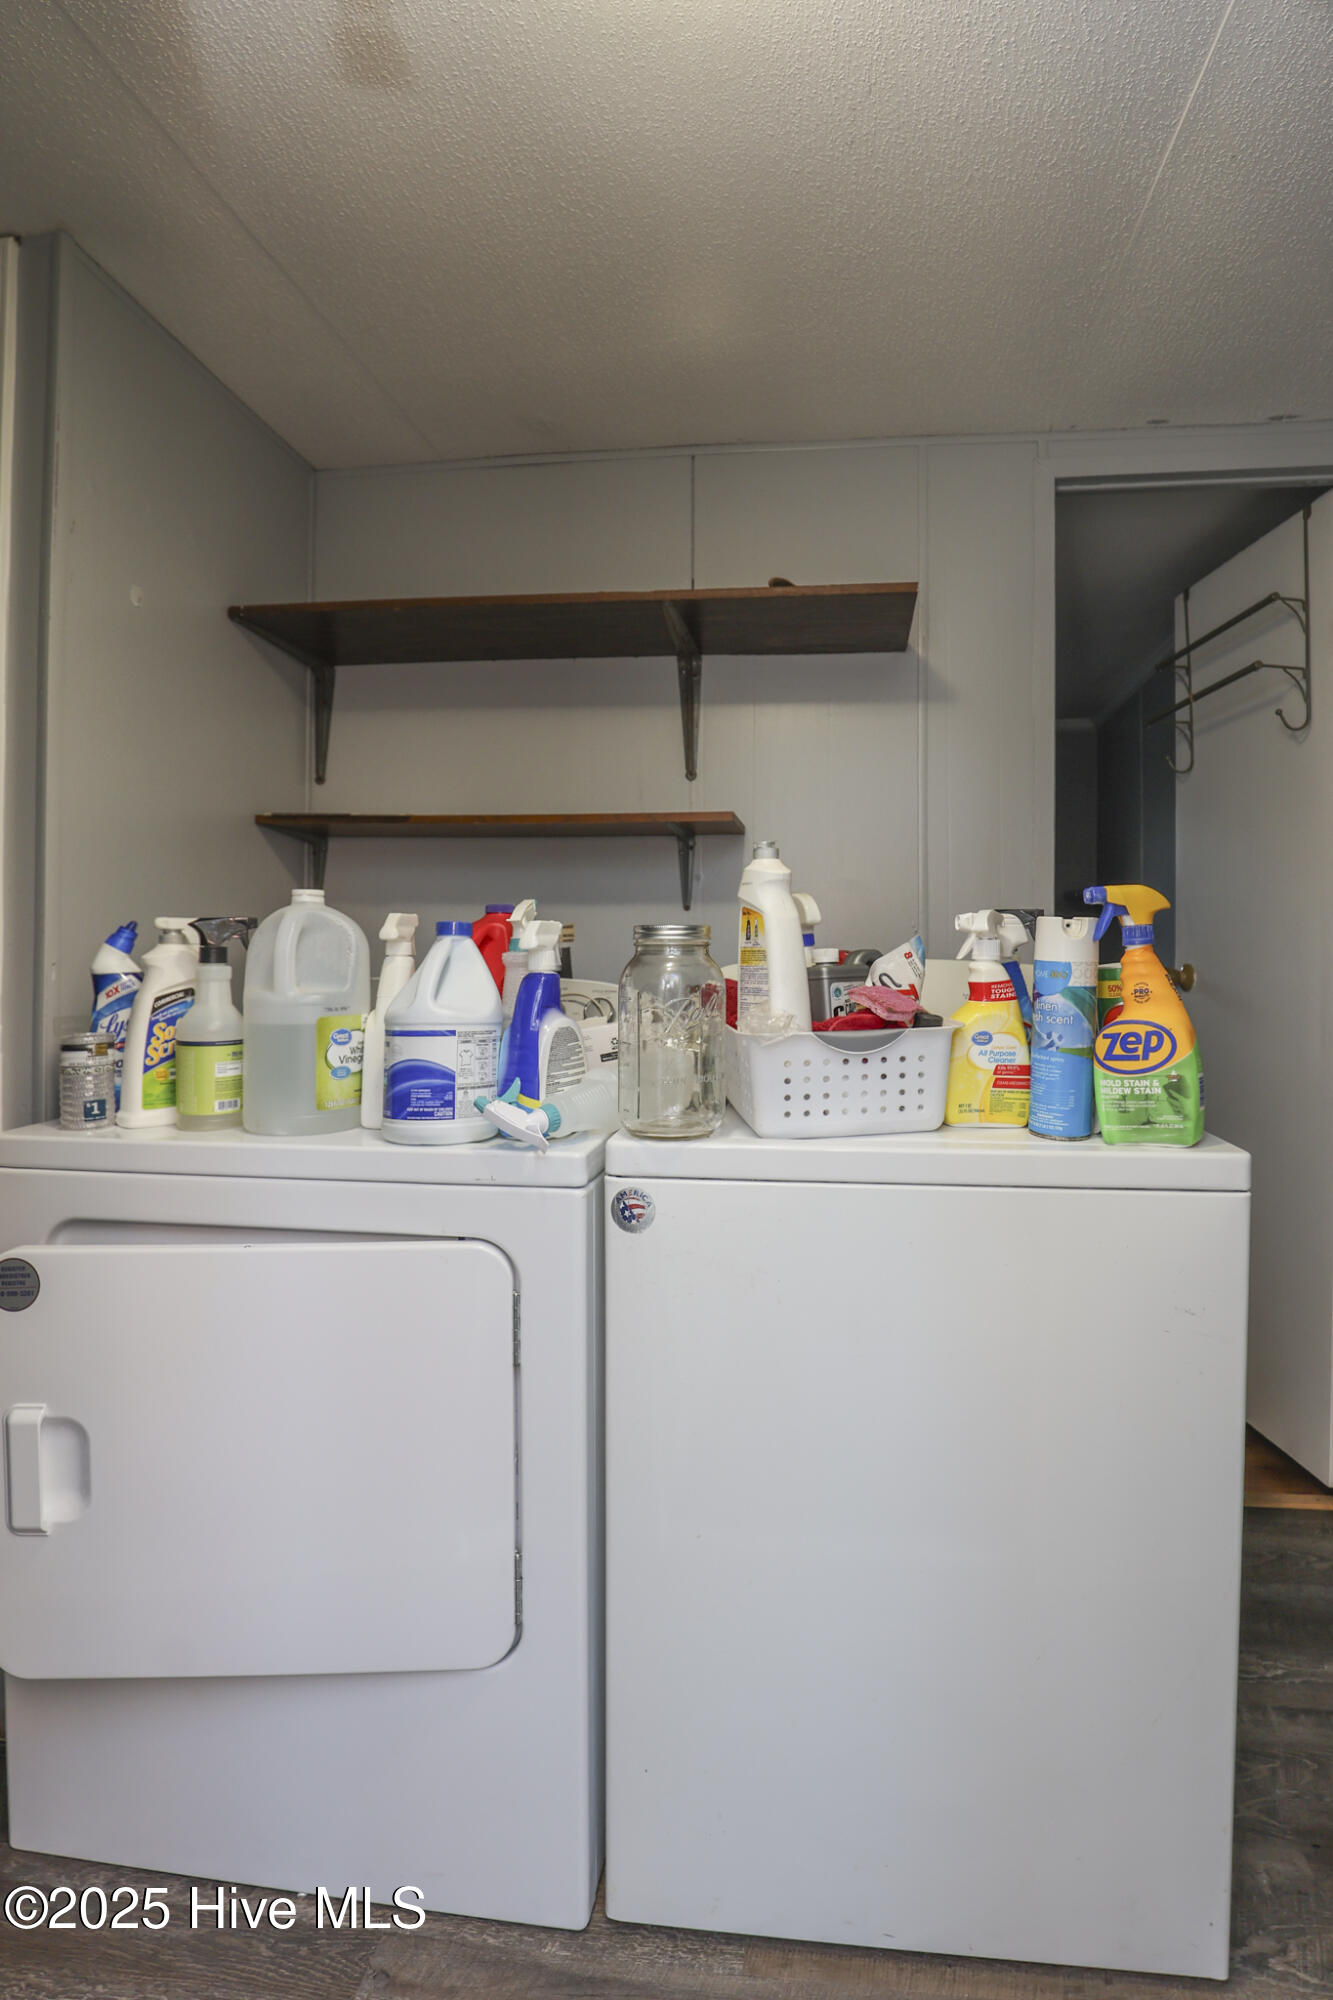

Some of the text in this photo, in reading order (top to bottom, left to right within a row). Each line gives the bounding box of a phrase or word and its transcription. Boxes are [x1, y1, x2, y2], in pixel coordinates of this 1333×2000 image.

[1046, 1014, 1074, 1025] scent
[989, 1049, 1017, 1058] Purpose
[1123, 1079, 1151, 1087] STAIN
[1152, 1079, 1161, 1087] &
[1133, 1087, 1162, 1095] STAIN
[616, 1189, 653, 1208] AMERICA
